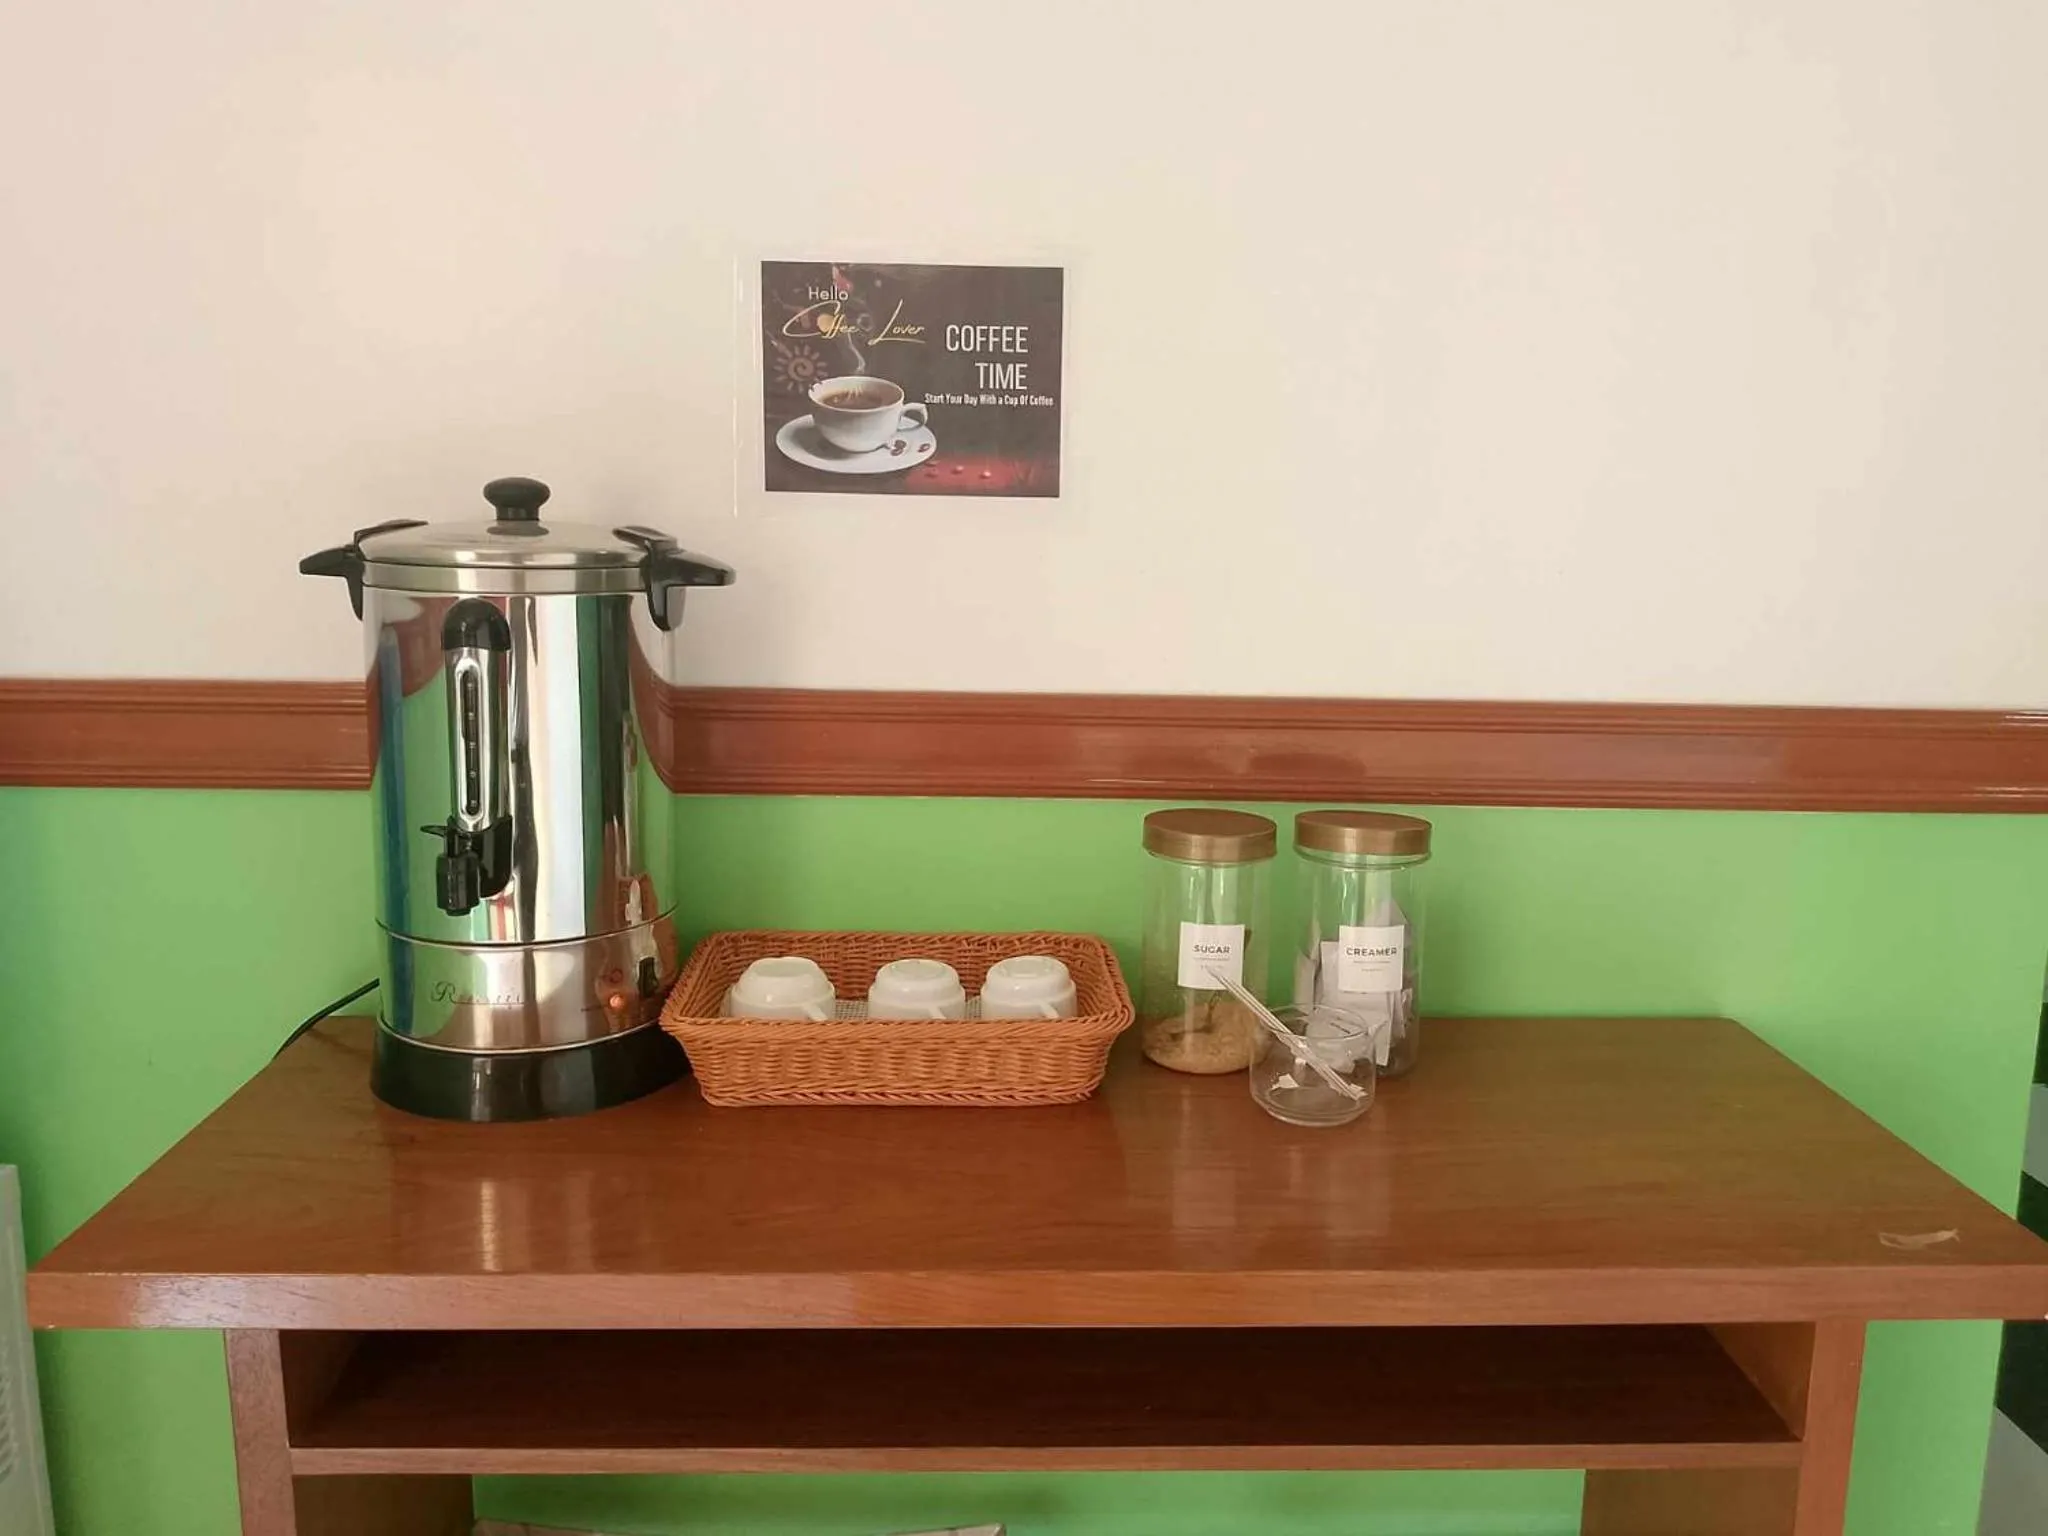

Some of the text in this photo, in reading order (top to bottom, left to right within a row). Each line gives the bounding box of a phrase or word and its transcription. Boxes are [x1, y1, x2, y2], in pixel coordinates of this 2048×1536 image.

[808, 286, 850, 302] Hello
[867, 298, 926, 346] Lover
[945, 324, 1029, 354] COFFEE
[974, 362, 1028, 391] TIME
[924, 392, 944, 404] Start
[945, 393, 962, 404] Your
[963, 394, 978, 406] Day
[979, 394, 997, 405] With
[1004, 394, 1018, 406] Cup
[1019, 394, 1029, 405] Of
[1029, 395, 1054, 406] Coffee
[1193, 944, 1231, 954] SUGAR
[1346, 947, 1398, 957] CREAMER
